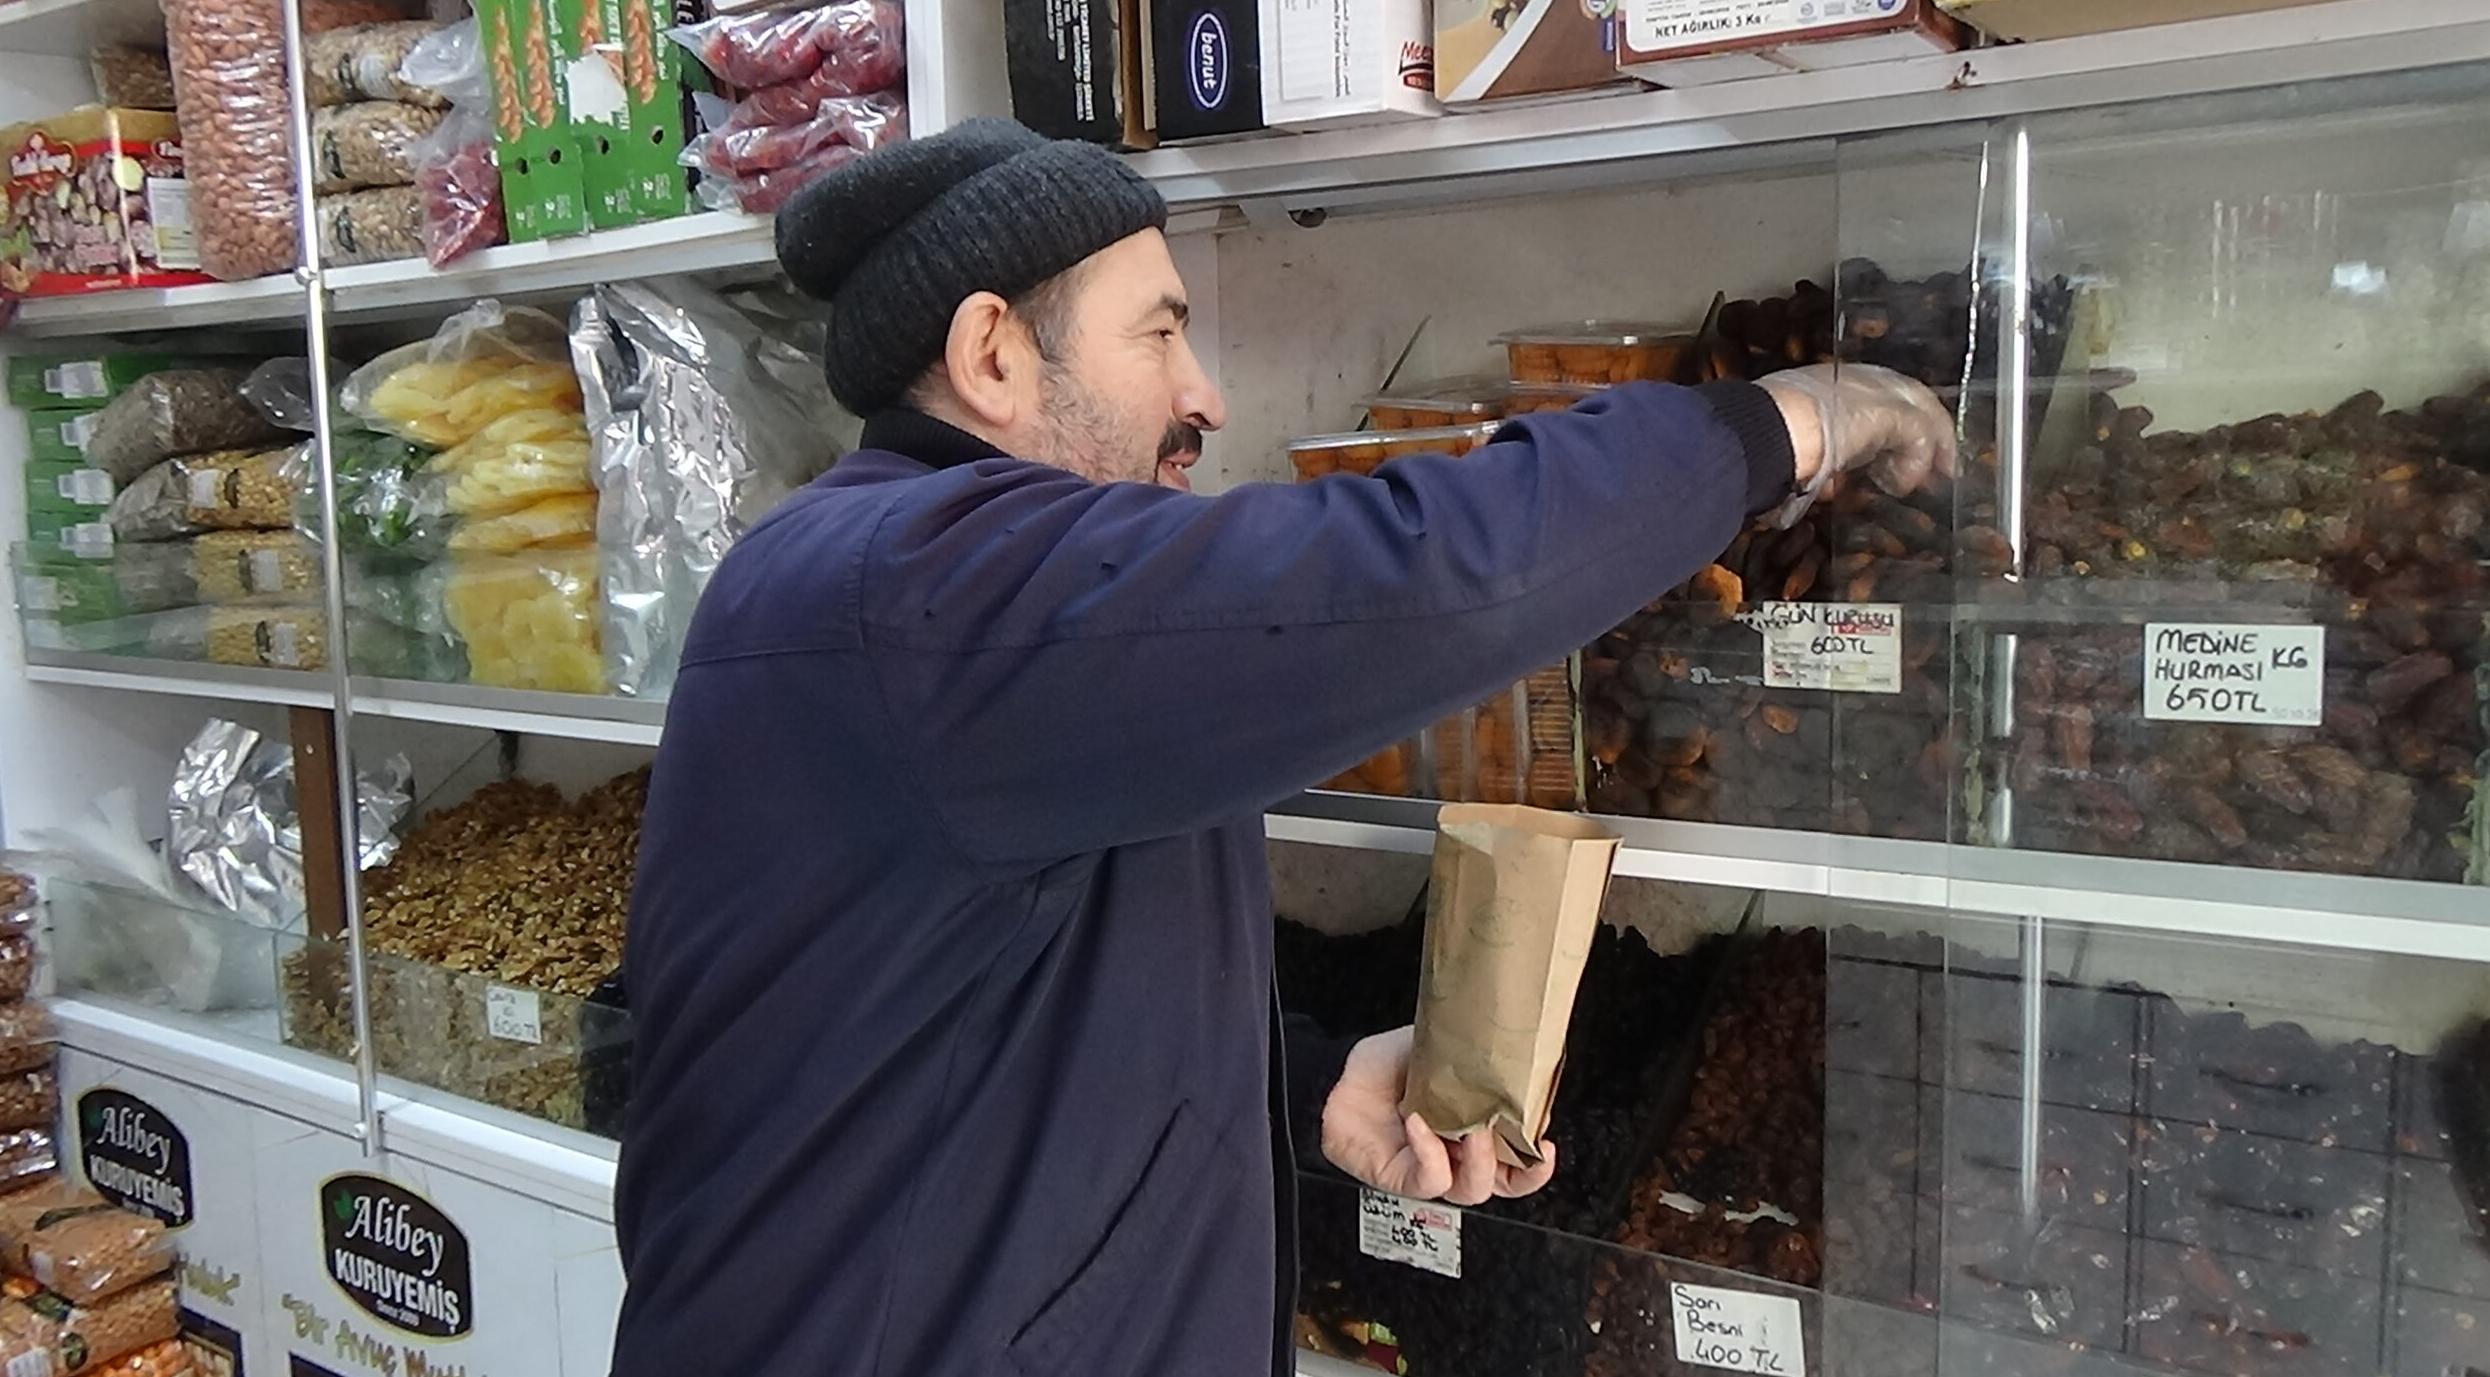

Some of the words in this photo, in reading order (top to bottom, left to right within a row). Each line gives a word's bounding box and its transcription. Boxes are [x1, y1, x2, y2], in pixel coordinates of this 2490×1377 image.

[1655, 25, 1677, 38] NET
[1201, 32, 1217, 89] benut
[2156, 629, 2258, 655] MEDİNE
[2271, 646, 2308, 669] KG
[2155, 658, 2262, 681] HURMASI
[96, 1107, 171, 1175] Alibey
[345, 1195, 444, 1277] Alibey
[334, 1248, 461, 1334] KURUYEMİŞ
[1695, 1338, 1742, 1365] 400
[1749, 1346, 1784, 1372] TL
